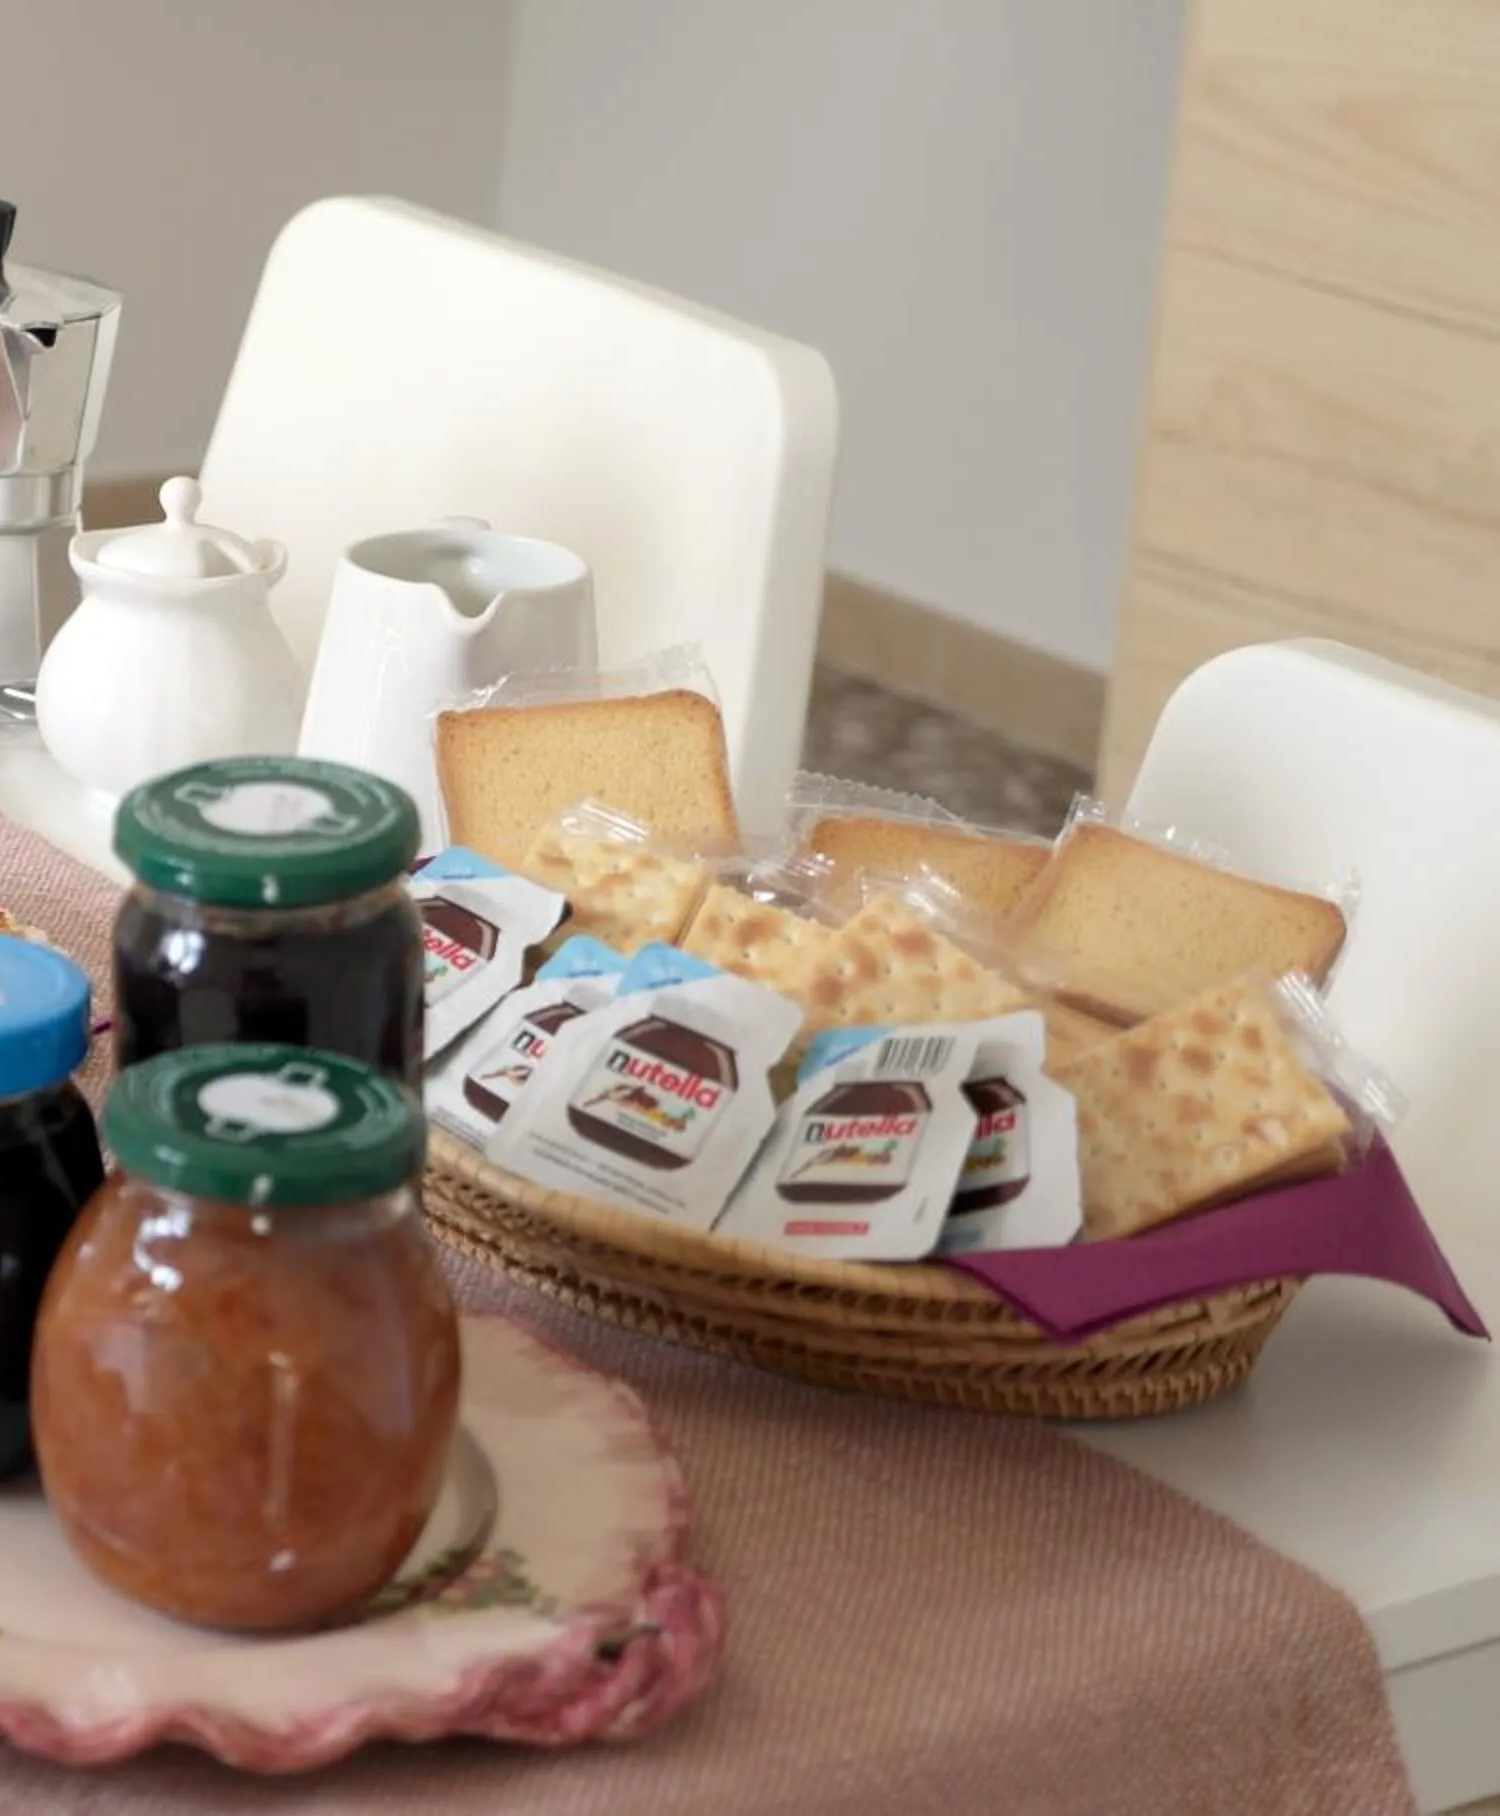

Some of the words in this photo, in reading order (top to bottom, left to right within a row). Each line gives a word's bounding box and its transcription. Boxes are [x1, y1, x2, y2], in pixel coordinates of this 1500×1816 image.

[423, 928, 476, 970] ella
[606, 1049, 720, 1109] nutella
[804, 1108, 918, 1142] nutella
